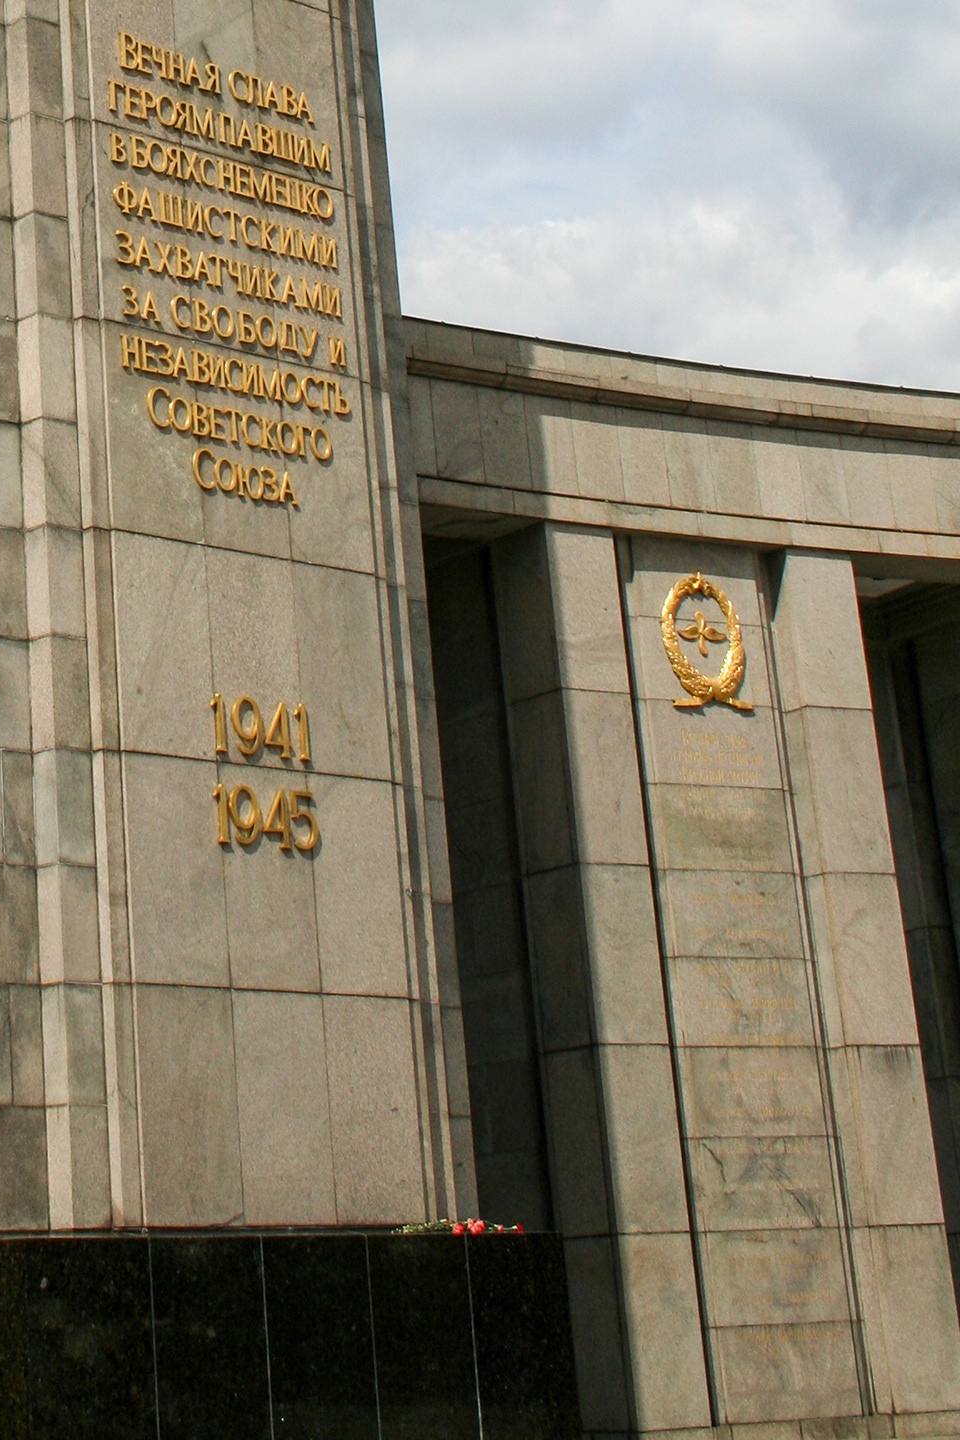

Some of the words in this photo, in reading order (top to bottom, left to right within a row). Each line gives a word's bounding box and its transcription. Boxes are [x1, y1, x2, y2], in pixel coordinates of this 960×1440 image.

[118, 30, 221, 94] ВЕЧНАЯ
[228, 69, 314, 123] СЛАВА
[108, 78, 215, 139] ГЕРОЯМ
[218, 111, 331, 172] ПАВШИМ
[110, 132, 126, 163] В
[129, 134, 201, 184] БОЯХ
[200, 157, 215, 187] С
[217, 157, 334, 219] НЕМЕЦКО
[112, 180, 337, 269] ФАШИСТСКИМИ
[115, 229, 342, 317] ЗАХВАТЧИКАМИ
[122, 284, 161, 322] ЗА
[169, 295, 317, 357] СВОБОДУ
[328, 335, 346, 366] И
[120, 333, 350, 414] НЕЗАВИСИМОСТЬ
[146, 386, 332, 460] СОВЕТСКОГО
[191, 448, 298, 505] СОЮЗА
[210, 692, 311, 762] 1941
[212, 783, 319, 850] 1945
